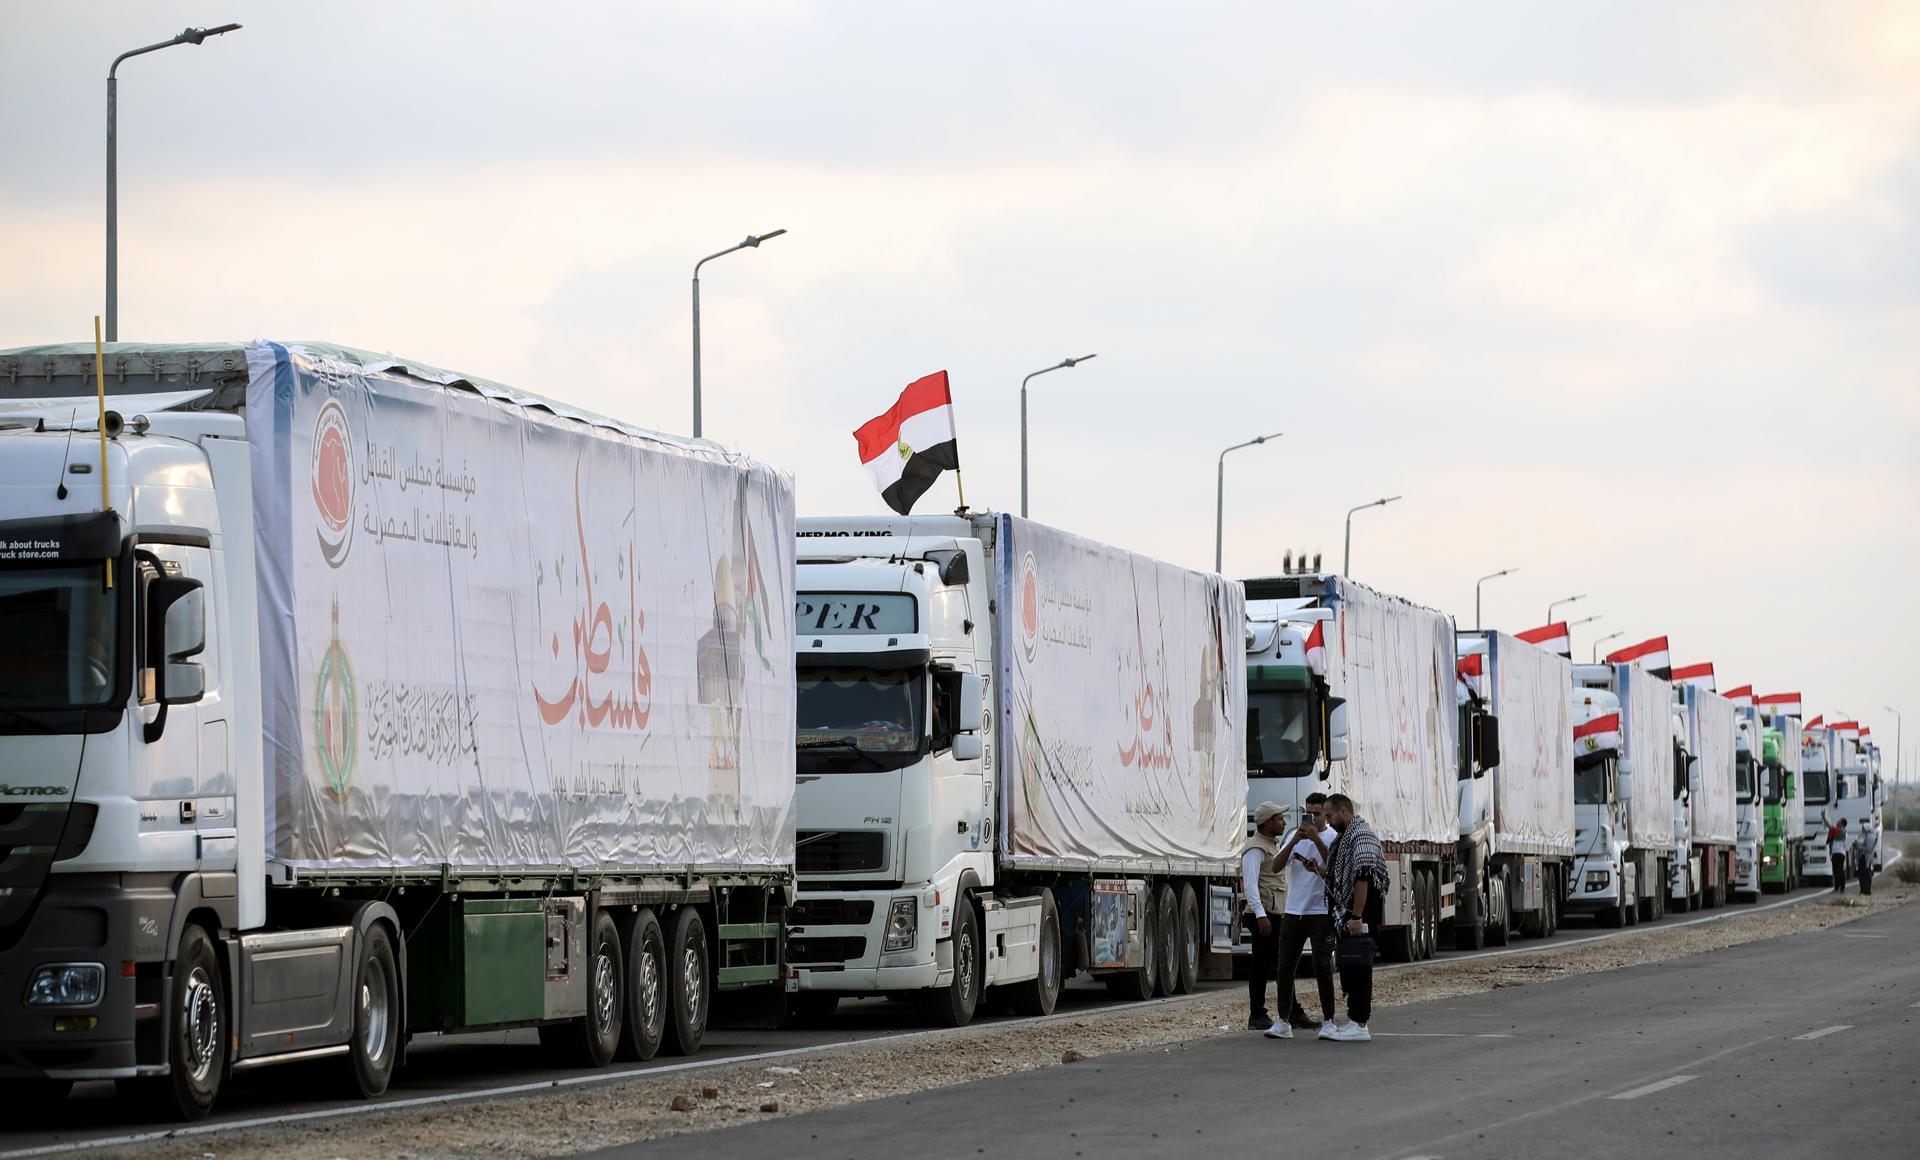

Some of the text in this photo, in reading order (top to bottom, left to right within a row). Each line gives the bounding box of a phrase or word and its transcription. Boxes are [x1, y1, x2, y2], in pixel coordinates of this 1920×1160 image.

[361, 442, 476, 503] مؤسسة مجلس القبائل
[9, 540, 32, 549] about
[34, 539, 60, 549] trucks
[363, 504, 478, 560] والعائلات المصرية
[18, 550, 59, 559] store.com
